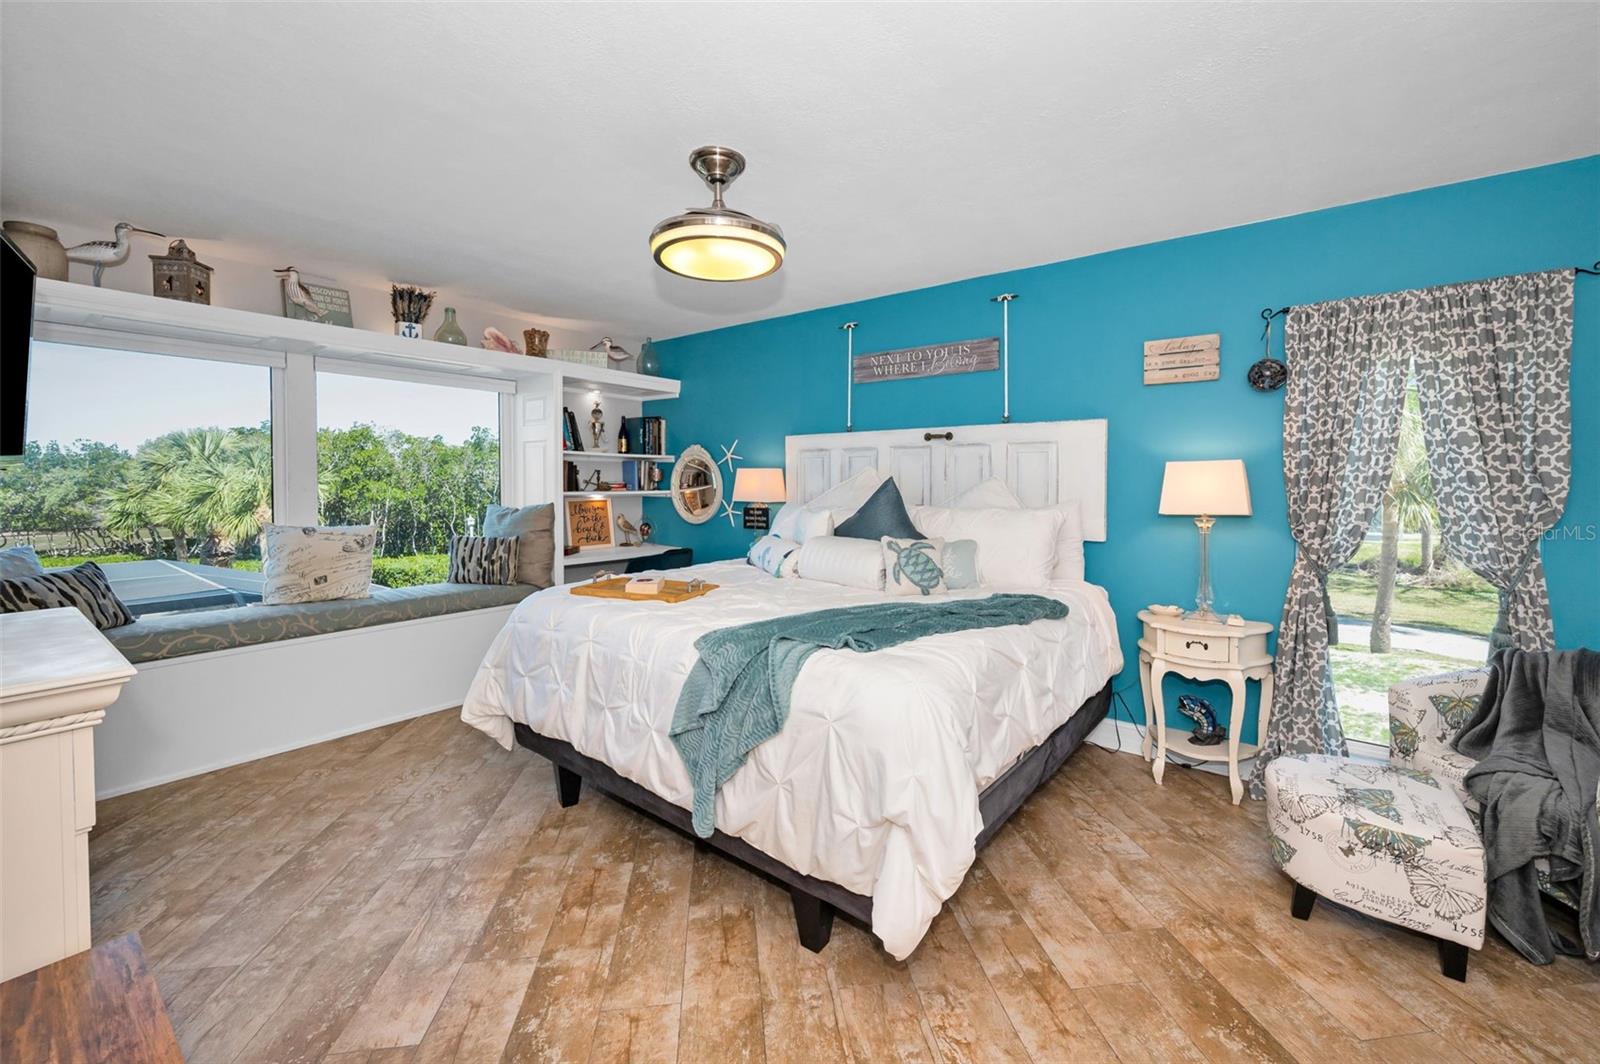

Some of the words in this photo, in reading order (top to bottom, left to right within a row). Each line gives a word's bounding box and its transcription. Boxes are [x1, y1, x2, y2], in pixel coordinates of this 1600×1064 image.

[871, 353, 901, 366] NEXT
[904, 351, 922, 362] TO
[926, 346, 953, 360] YOU
[957, 344, 971, 355] IS
[873, 361, 918, 376] WHERE
[921, 360, 926, 371] I
[1299, 825, 1324, 843] 1758
